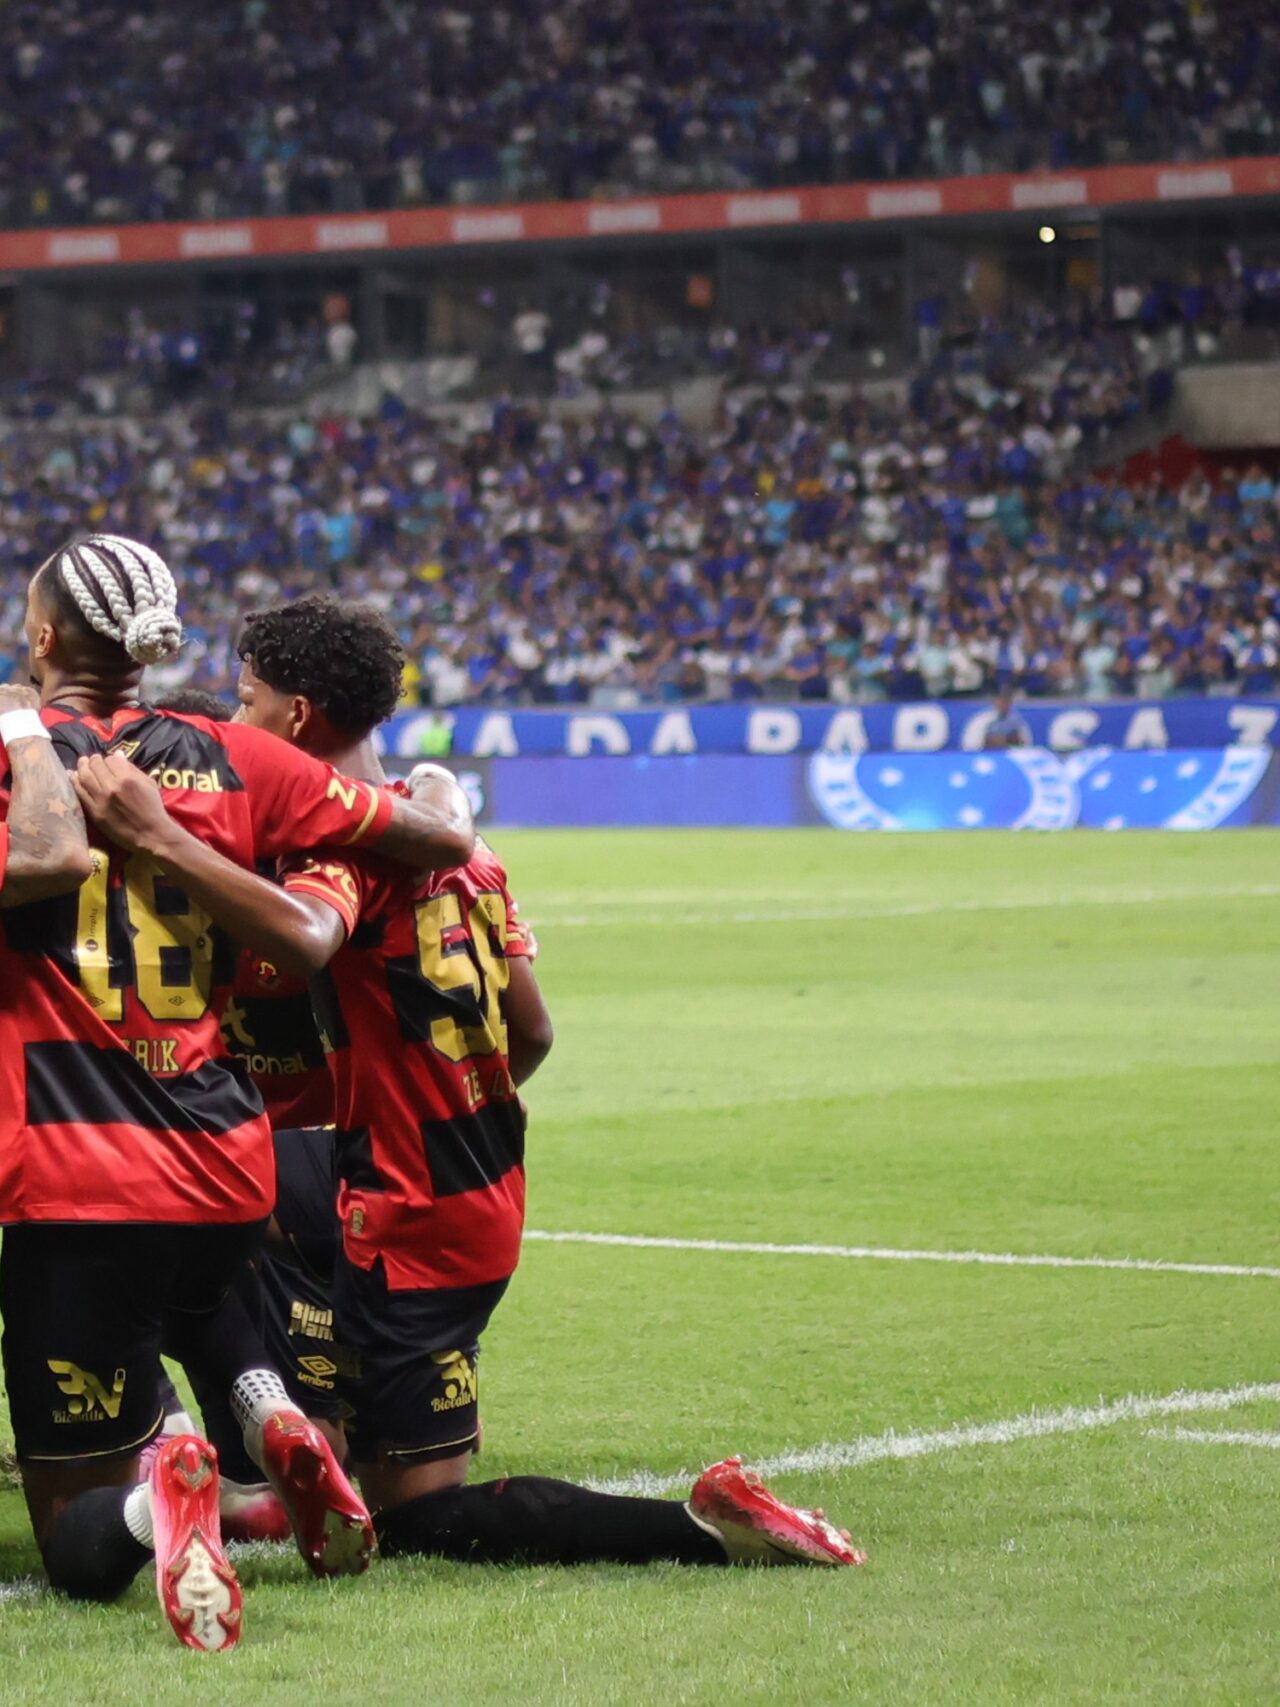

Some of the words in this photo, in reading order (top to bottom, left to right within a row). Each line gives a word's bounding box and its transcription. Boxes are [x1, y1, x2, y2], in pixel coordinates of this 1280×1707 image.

[76, 848, 214, 1021] 18
[124, 1039, 180, 1073] RIK
[297, 1371, 335, 1389] umbro
